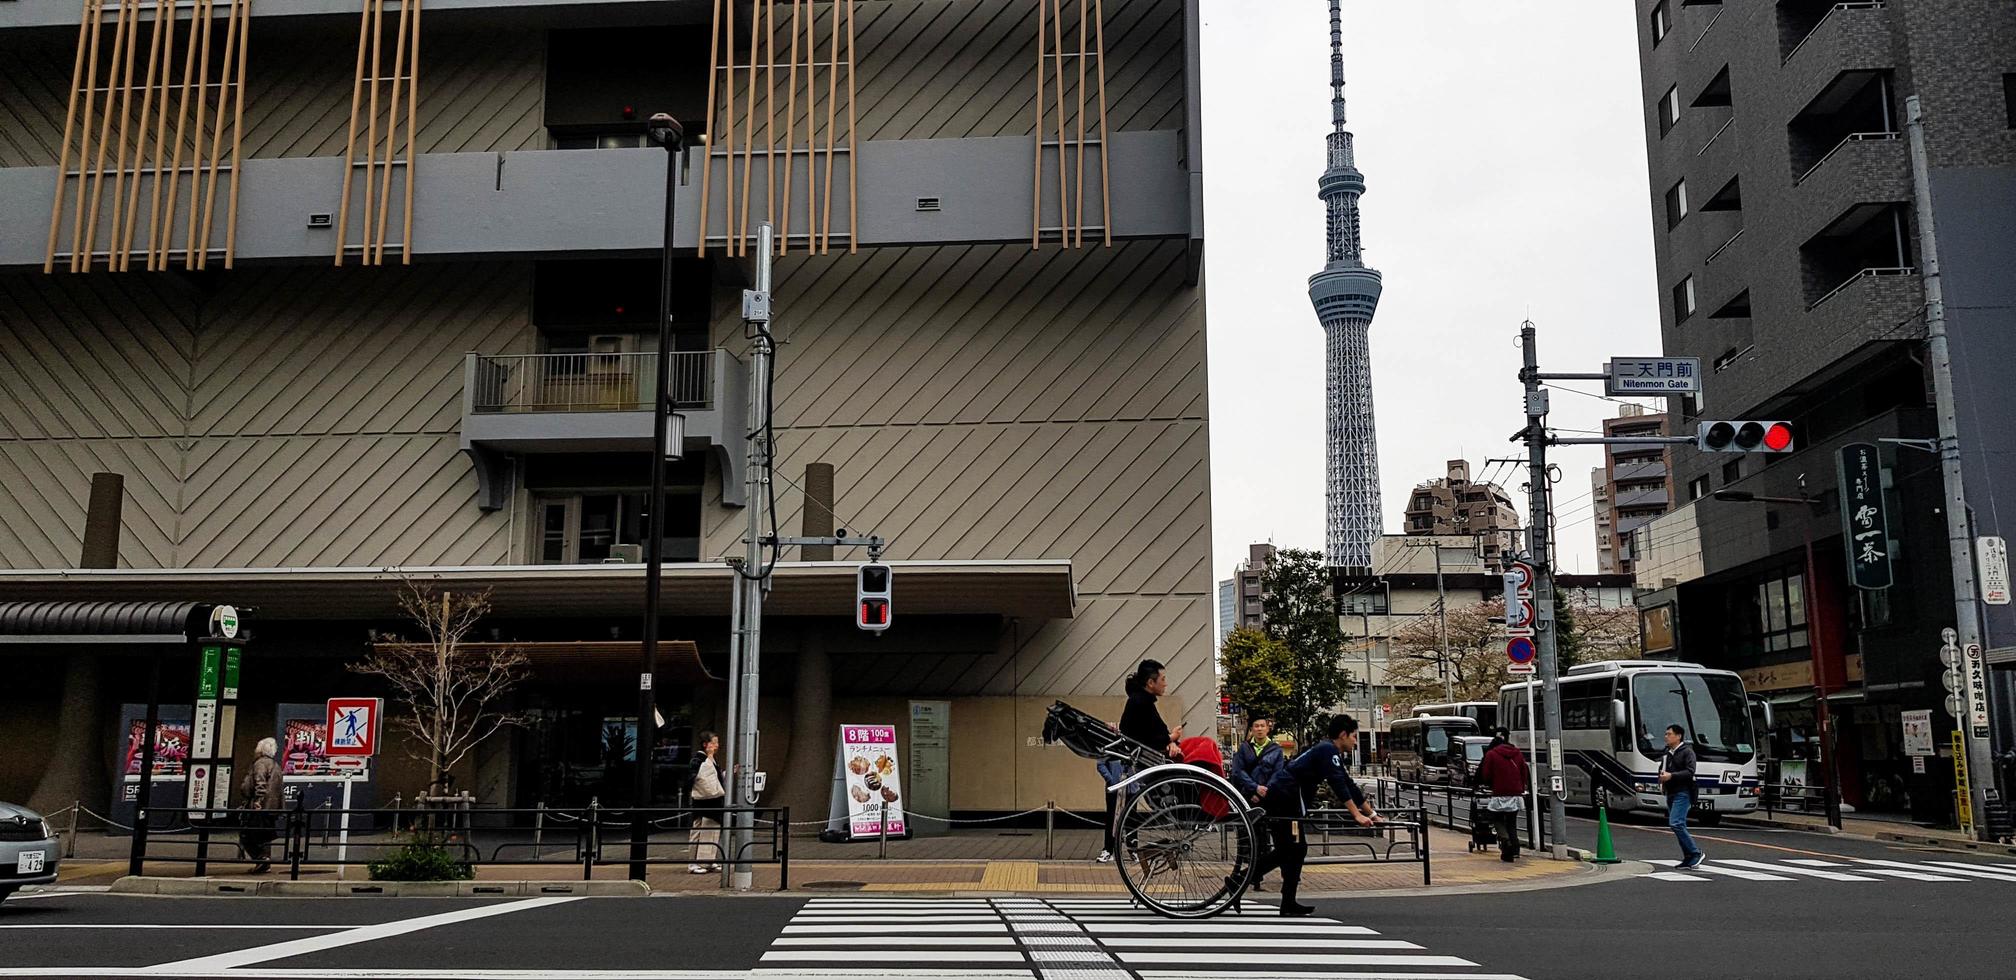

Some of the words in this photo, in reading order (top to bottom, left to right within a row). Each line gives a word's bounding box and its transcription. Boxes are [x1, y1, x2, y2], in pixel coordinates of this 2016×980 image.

[1619, 362, 1692, 377] 二天門前
[1623, 380, 1665, 388] Nitenmon
[1668, 380, 1689, 388] Gate
[850, 745, 891, 753] ランチメニュー
[1722, 770, 1741, 783] R
[284, 785, 298, 795] 4F
